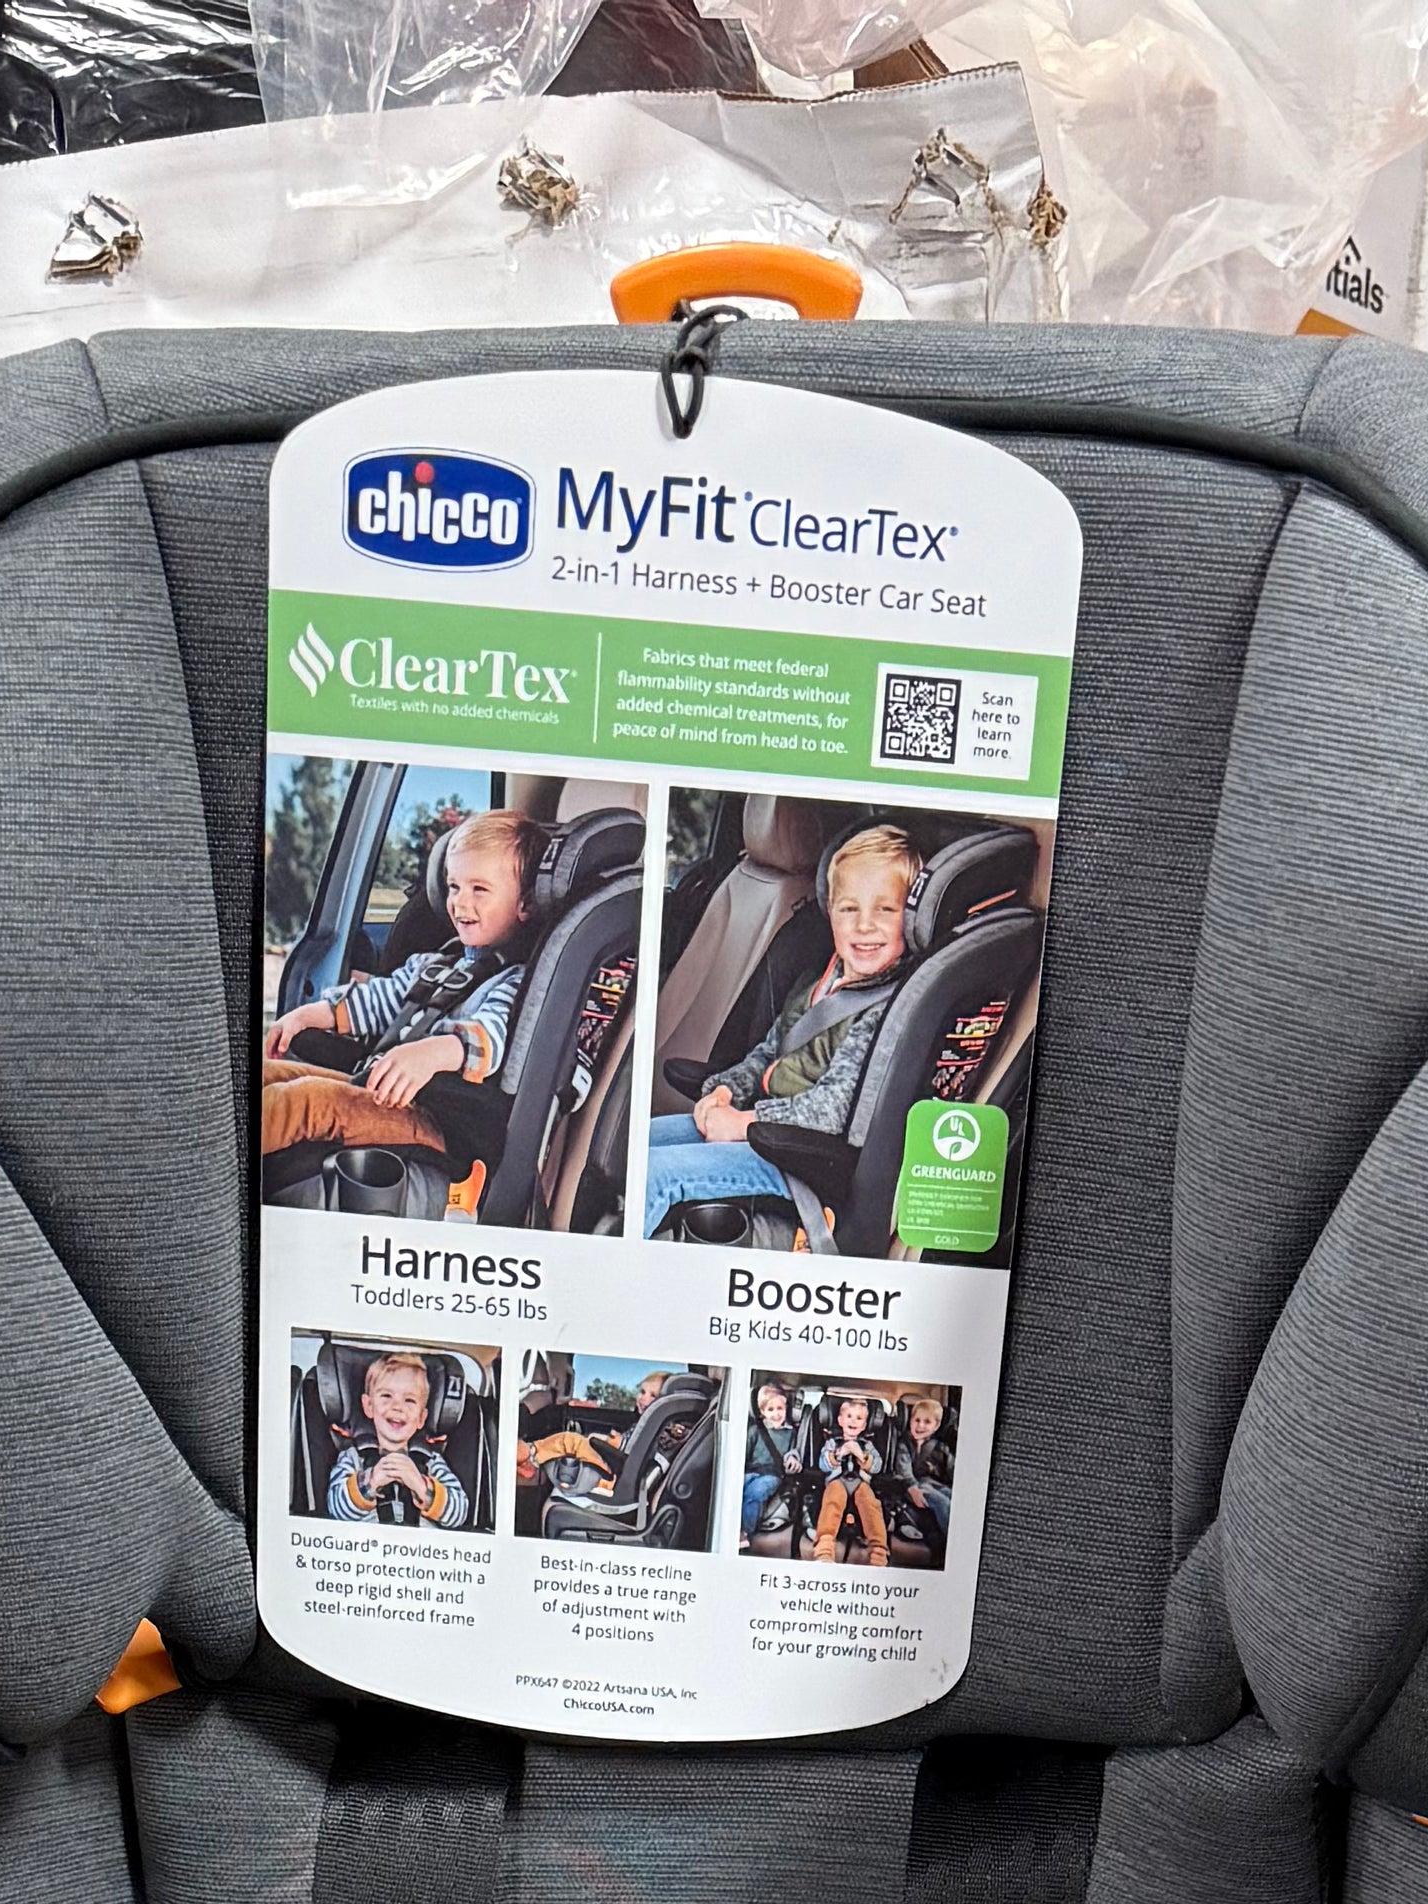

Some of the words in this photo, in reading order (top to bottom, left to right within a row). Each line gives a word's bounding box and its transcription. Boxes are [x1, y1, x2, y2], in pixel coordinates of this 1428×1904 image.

[358, 461, 519, 545] chicco
[556, 466, 737, 553] MyFit
[551, 555, 620, 586] 2-in-1
[632, 563, 738, 595] Harness
[746, 578, 761, 593] +
[770, 574, 871, 606] Booster
[879, 584, 923, 611] Car
[930, 588, 988, 617] Seat
[339, 637, 571, 704] ClearTex
[643, 648, 695, 667] Fabrics
[698, 652, 730, 670] that
[734, 658, 772, 674] meet
[776, 658, 829, 678] federal
[617, 670, 712, 696] flammability
[715, 680, 789, 700] standards
[792, 686, 851, 705] without
[982, 692, 1013, 706] Scan
[350, 694, 398, 712] Textiles
[401, 698, 429, 714] with
[432, 704, 449, 716] no
[452, 702, 493, 720] added
[496, 705, 559, 724] chemicals
[616, 696, 664, 713] added
[667, 701, 733, 720] chemical
[736, 707, 823, 729] treatments,
[826, 712, 848, 729] for
[972, 709, 1003, 723] here
[1007, 712, 1020, 725] to
[613, 721, 657, 738] peace
[660, 722, 676, 739] of
[679, 726, 717, 743] mind
[721, 728, 757, 747] from
[761, 731, 798, 750] head
[801, 736, 817, 752] to
[820, 738, 849, 754] toe.
[977, 727, 1011, 742] learn
[973, 746, 1012, 760] more.
[911, 1165, 997, 1183] GREENGUARD
[362, 1235, 542, 1290] Harness
[350, 1283, 445, 1311] Toddlers
[451, 1293, 510, 1317] 25-65
[517, 1298, 547, 1320] lbs
[728, 1268, 902, 1320] Booster
[709, 1316, 741, 1343] Big
[748, 1319, 792, 1342] Kids
[798, 1324, 871, 1348] 40-100
[878, 1329, 908, 1351] lbs
[382, 1542, 449, 1560] provides
[453, 1548, 491, 1564] head
[295, 1554, 308, 1568] &
[311, 1556, 351, 1573] torso
[355, 1563, 435, 1581] protection
[439, 1568, 473, 1584] with
[477, 1573, 485, 1585] a
[541, 1555, 637, 1577] Best-in-class
[640, 1565, 692, 1581] recline
[315, 1578, 354, 1598] deep
[358, 1583, 392, 1600] rigid
[396, 1585, 431, 1601] shell
[435, 1590, 464, 1604] and
[533, 1578, 600, 1596] provides
[603, 1585, 613, 1596] a
[617, 1584, 649, 1599] true
[653, 1588, 697, 1606] range
[760, 1573, 778, 1589] Fit
[782, 1575, 847, 1593] 3-across
[851, 1579, 880, 1596] into
[884, 1585, 920, 1600] your
[304, 1600, 425, 1623] steel-reinforced
[429, 1609, 476, 1627] frame
[542, 1598, 558, 1612] of
[561, 1601, 649, 1621] adjustment
[653, 1609, 686, 1624] with
[780, 1598, 832, 1614] vehicle
[836, 1602, 896, 1618] without
[571, 1623, 581, 1636] 4
[584, 1625, 655, 1642] positions
[749, 1617, 858, 1640] compromising
[861, 1625, 923, 1641] comfort
[752, 1636, 774, 1651] for
[776, 1641, 813, 1656] your
[815, 1644, 877, 1662] growing
[880, 1646, 917, 1662] child
[603, 1682, 648, 1696] Artsana
[563, 1697, 655, 1716] ChiccoUSA.com
